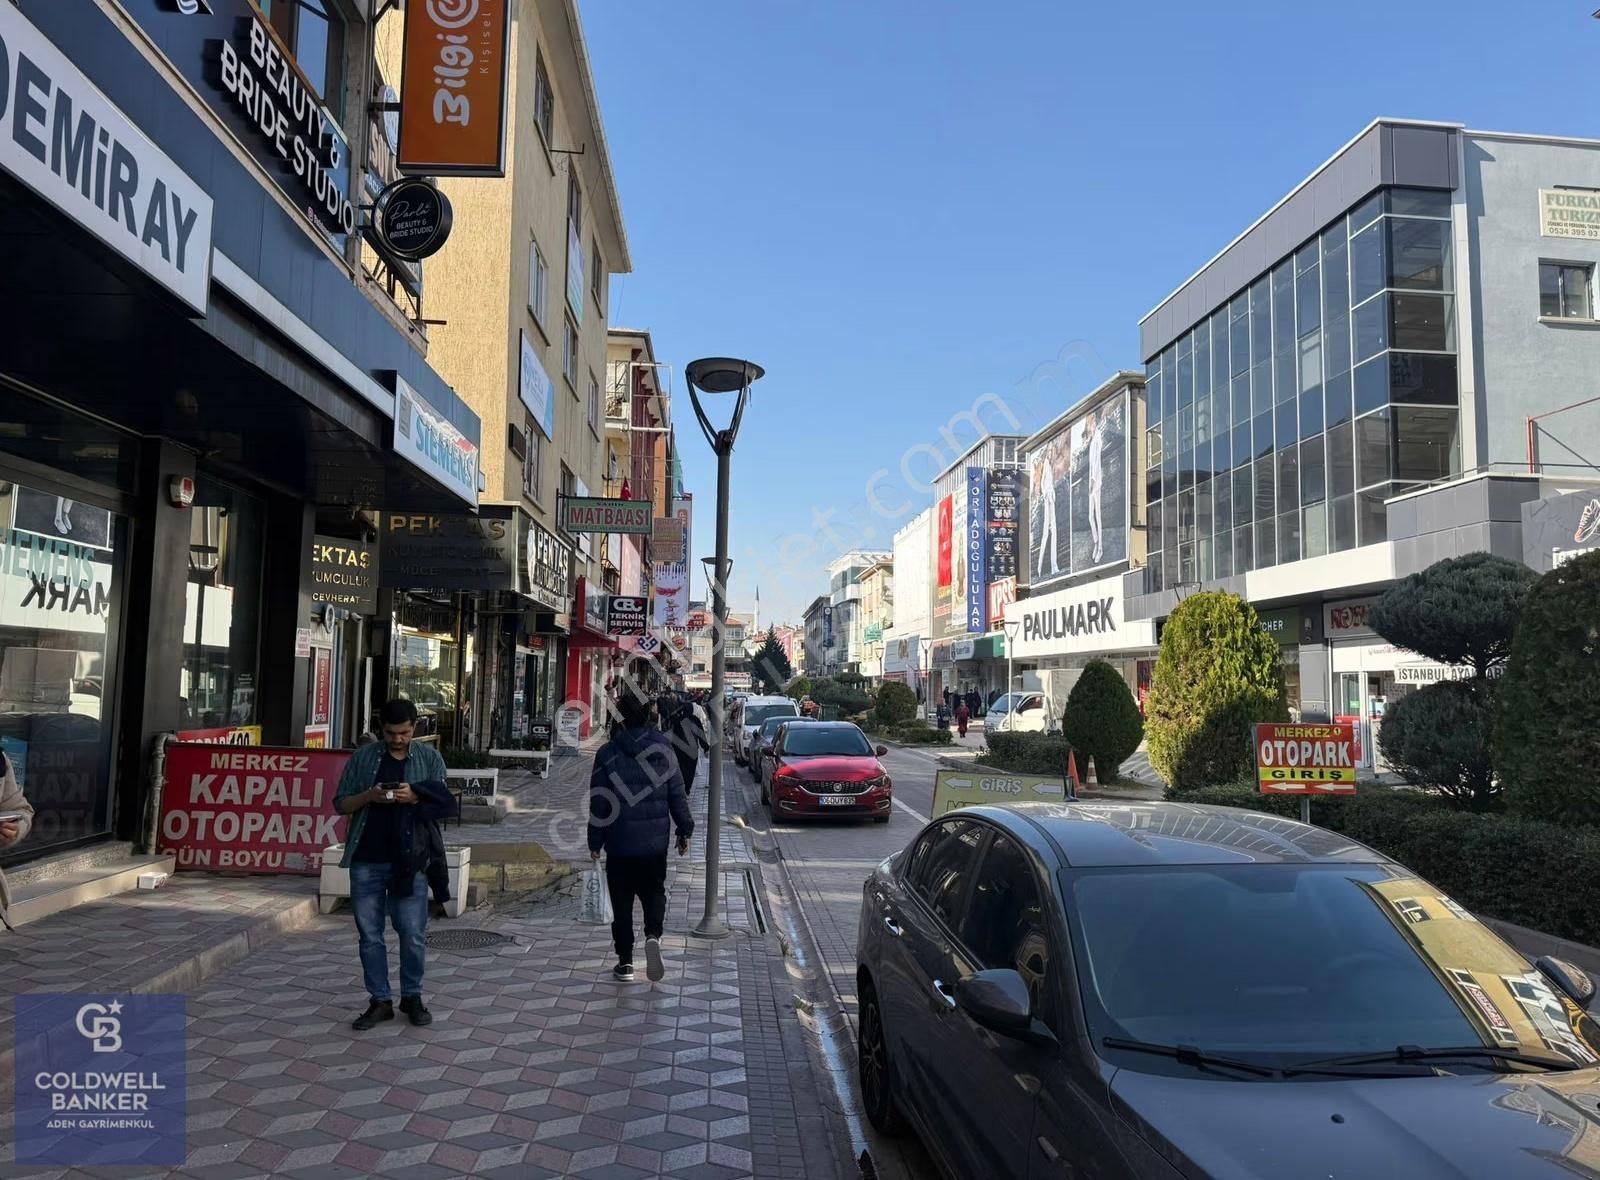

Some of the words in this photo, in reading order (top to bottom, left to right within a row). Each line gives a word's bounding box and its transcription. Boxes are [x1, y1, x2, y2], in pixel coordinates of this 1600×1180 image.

[250, 16, 327, 149] BEAUTY
[329, 132, 341, 170] &
[220, 40, 289, 158] BRIDE
[292, 137, 355, 235] STUDIO
[389, 229, 409, 240] BRIDE
[410, 226, 434, 236] STUDIO
[396, 219, 421, 230] BEAUTY
[1549, 227, 1569, 235] 0534
[570, 507, 649, 526] MATBAASI
[610, 612, 646, 620] TEKNİK
[610, 620, 644, 628] SERVİS
[1023, 597, 1117, 642] PAULMARK
[1398, 667, 1446, 682] İSTANBUL
[1274, 727, 1330, 738] MERKEZ
[210, 753, 310, 773] MERKEZ
[1261, 740, 1351, 767] OTOPARK
[1272, 768, 1342, 781] GİRİŞ
[189, 774, 324, 808] KAPALI
[980, 776, 1023, 795] GİRİŞ
[162, 809, 342, 845] OTOPARK
[219, 848, 283, 868] BOYU
